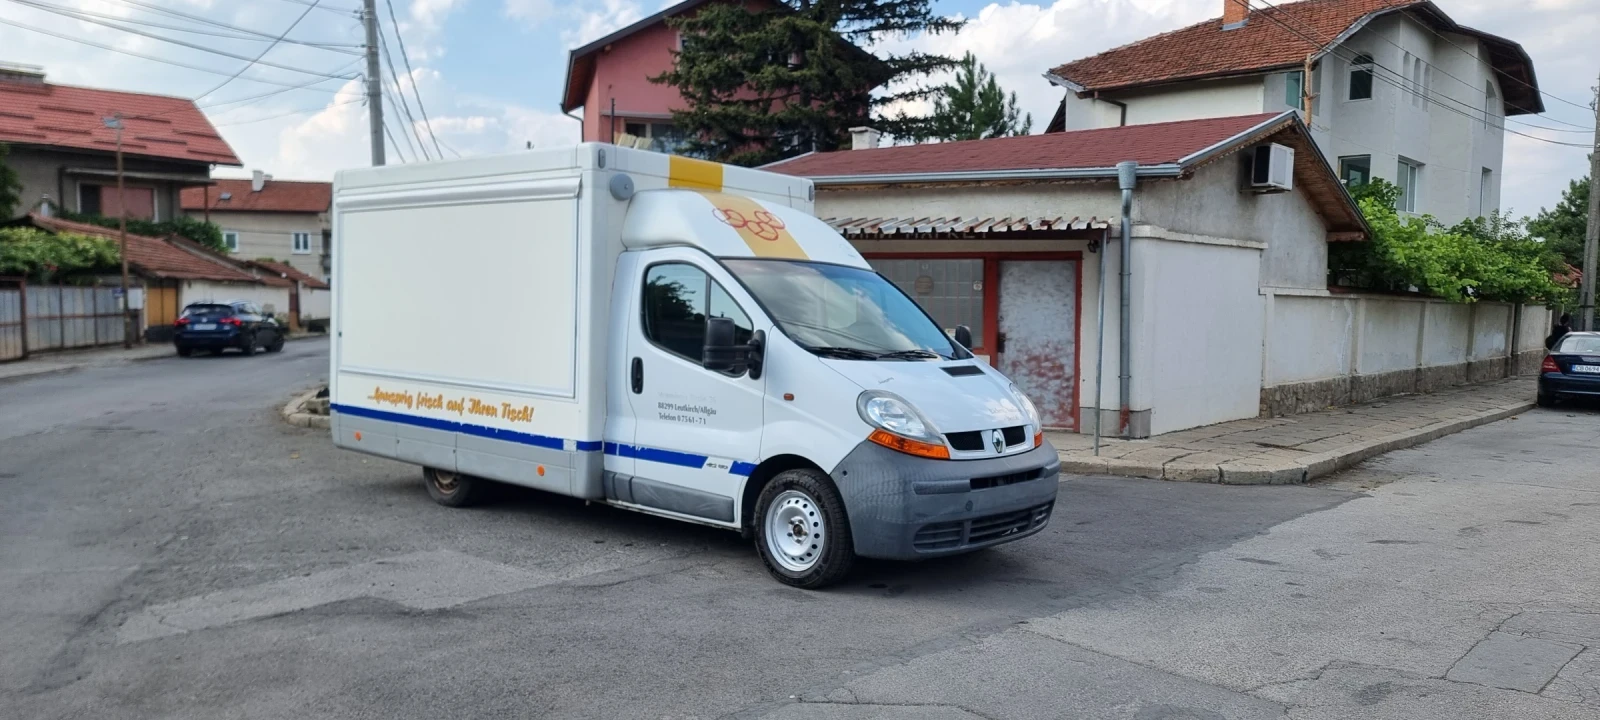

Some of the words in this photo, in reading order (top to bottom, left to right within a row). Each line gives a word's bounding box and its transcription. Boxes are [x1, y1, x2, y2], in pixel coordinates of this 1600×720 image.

[416, 391, 443, 410] frisch
[446, 396, 465, 417] auf
[501, 402, 534, 423] Tisch!
[658, 402, 673, 411] 88299
[659, 412, 676, 421] Telefon
